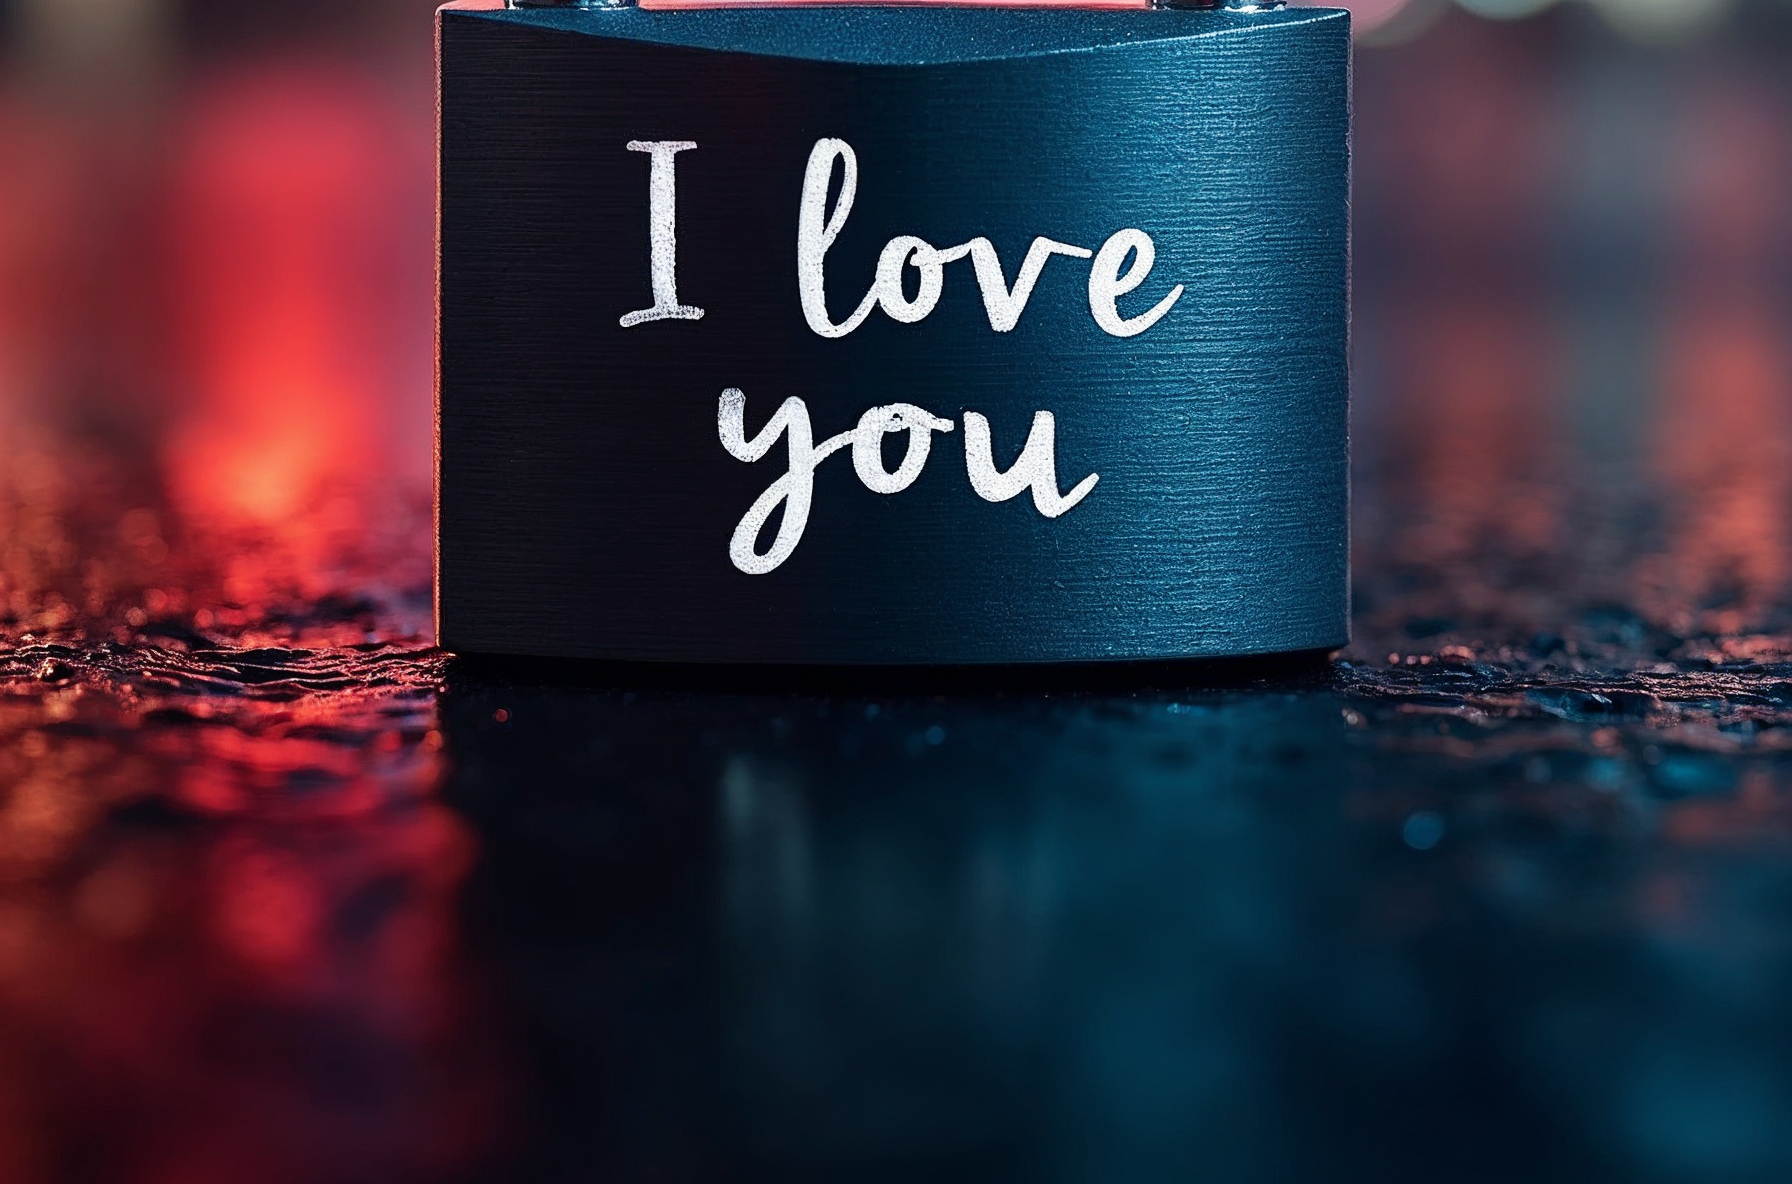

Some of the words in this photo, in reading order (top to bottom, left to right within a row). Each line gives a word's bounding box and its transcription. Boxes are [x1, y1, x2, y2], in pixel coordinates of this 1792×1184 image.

[619, 139, 705, 329] I
[797, 137, 1185, 339] love
[717, 387, 1100, 575] you
